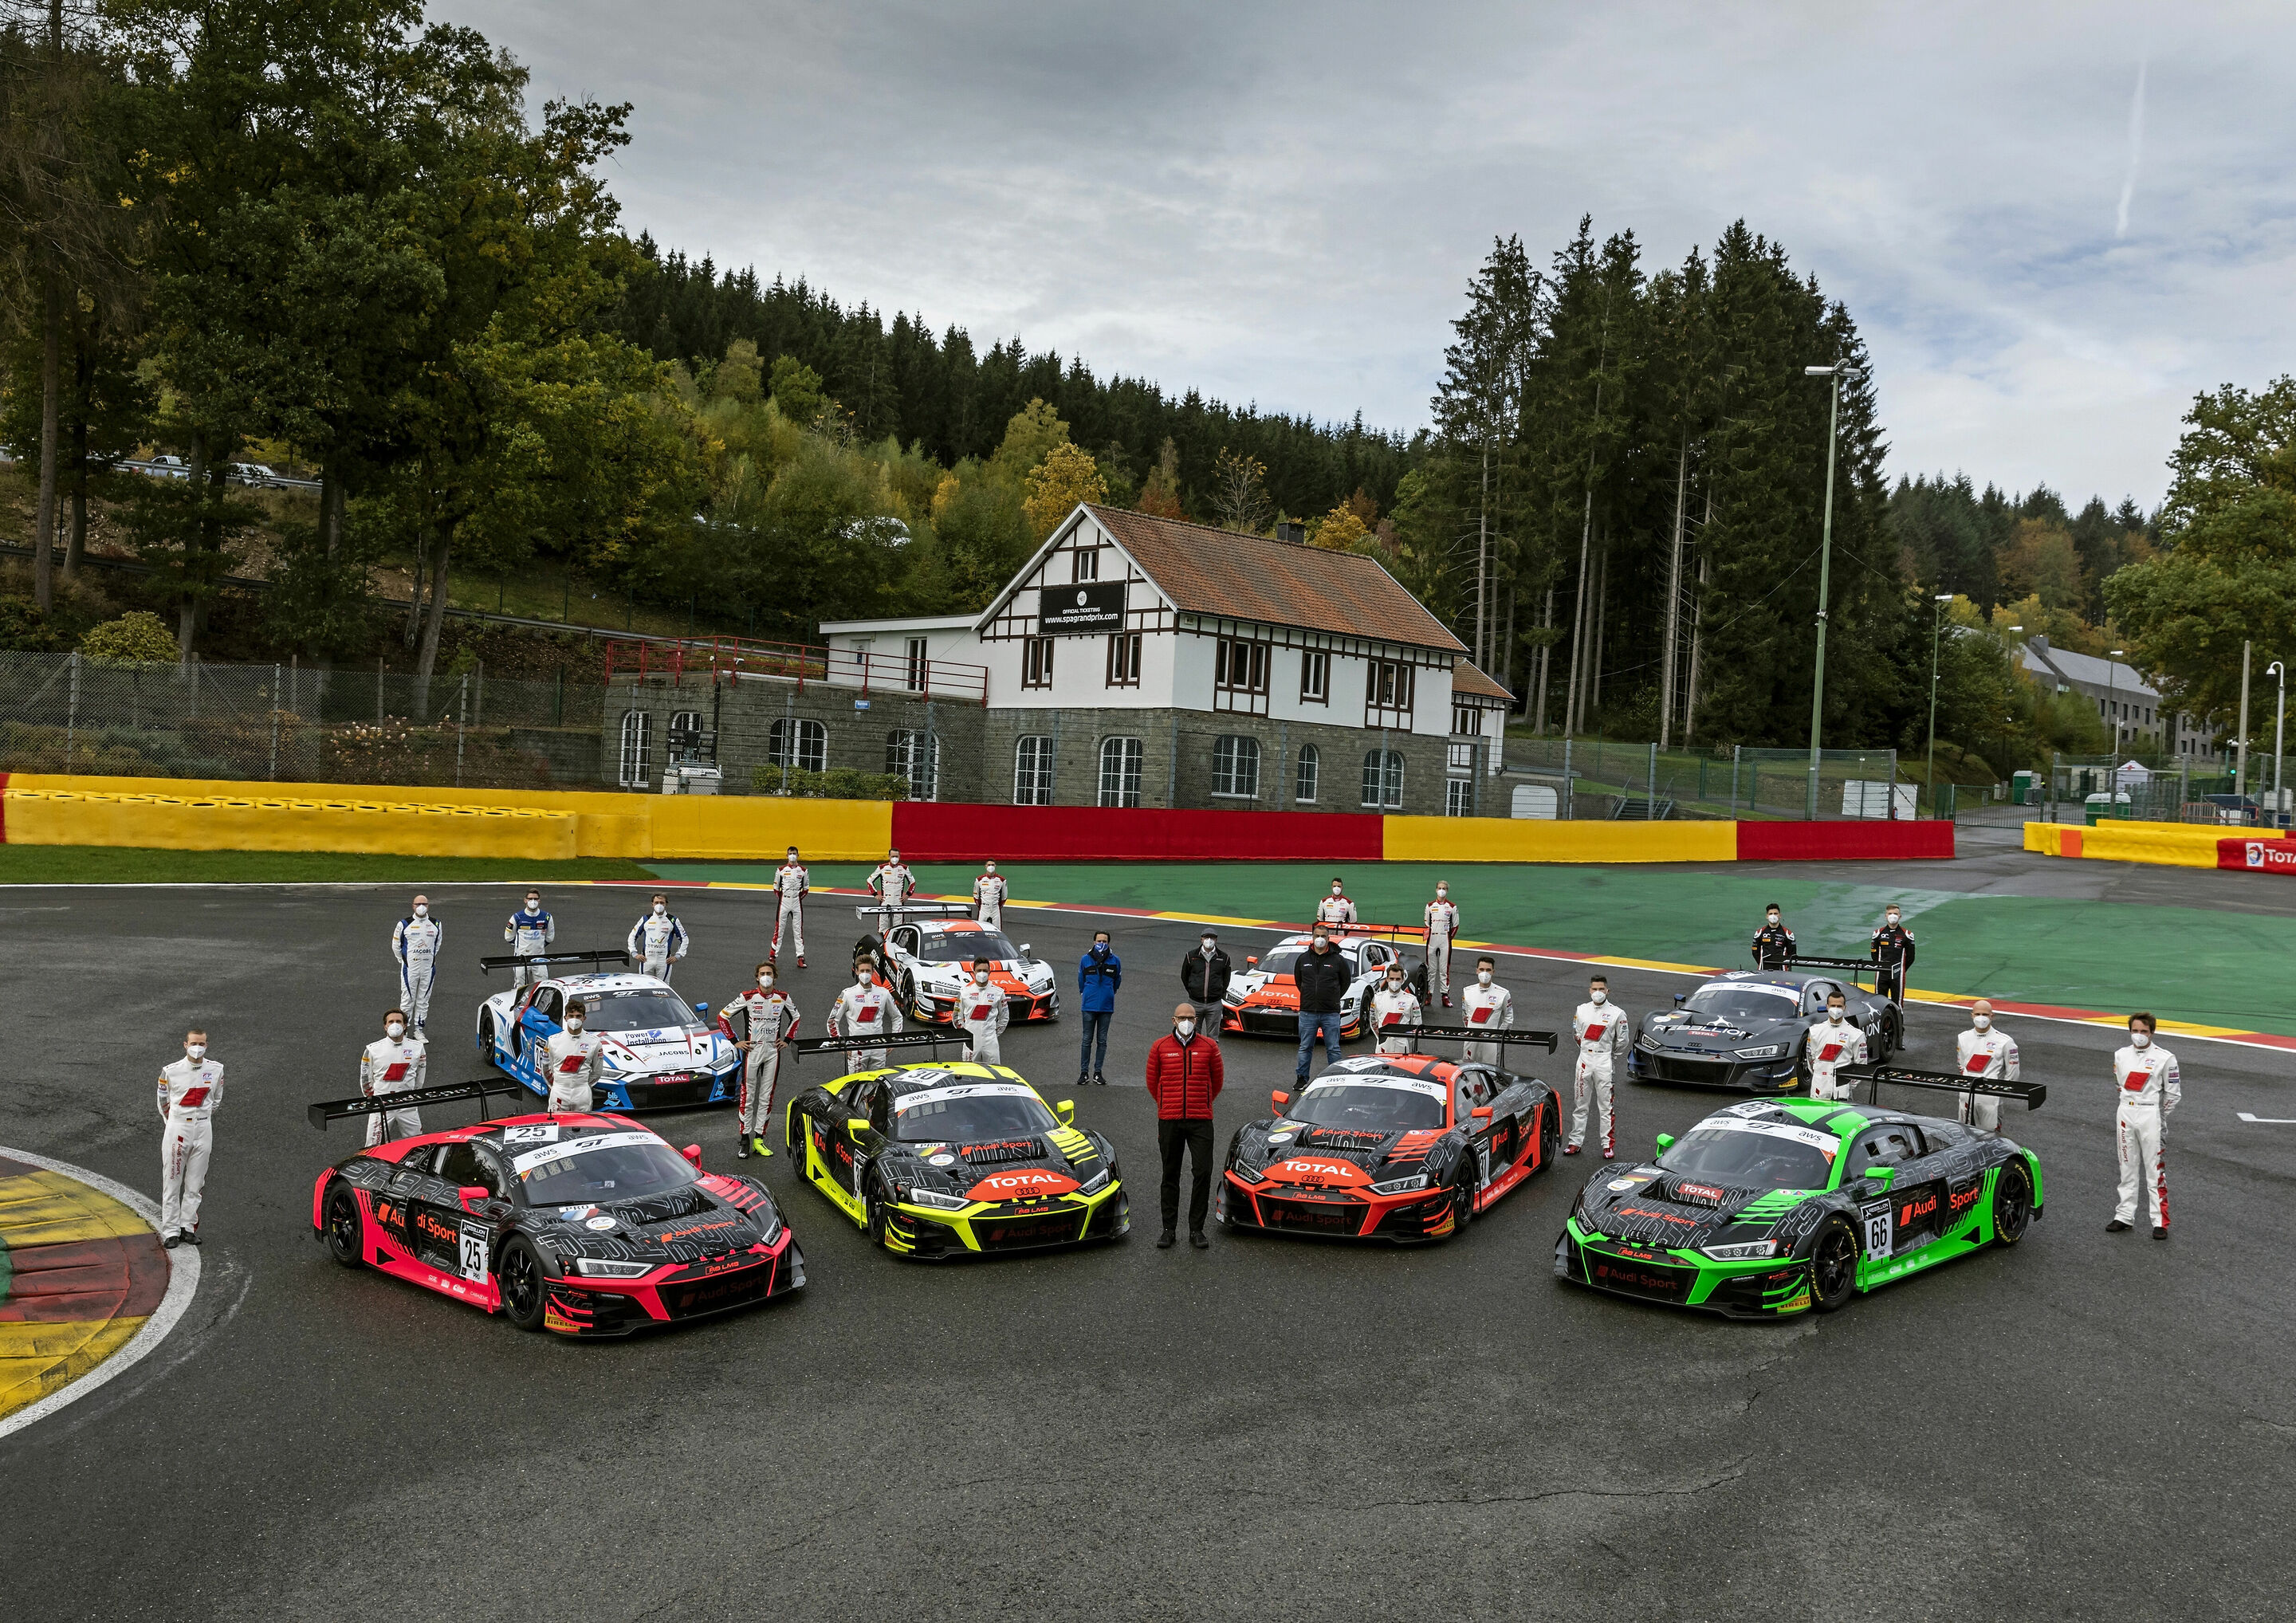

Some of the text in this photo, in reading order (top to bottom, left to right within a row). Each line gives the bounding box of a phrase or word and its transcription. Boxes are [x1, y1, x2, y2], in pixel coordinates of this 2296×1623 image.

[1045, 613, 1118, 623] www.spagrandprix.com
[627, 1036, 666, 1045] Installation
[908, 1070, 937, 1080] 30
[1412, 1082, 1432, 1091] aws
[909, 1093, 930, 1102] aws
[1710, 1118, 1732, 1126] aws
[517, 1127, 547, 1138] 25
[1354, 1130, 1383, 1140] Sport
[1799, 1130, 1822, 1142] aws
[576, 1138, 610, 1149] GT
[975, 1141, 1032, 1151] Audi Sport
[534, 1148, 557, 1159] aws
[1284, 1161, 1353, 1177] TOTAL
[985, 1175, 1062, 1189] TOTAL
[1684, 1185, 1718, 1198] TOTAL
[1913, 1188, 1978, 1217] Audi Sport
[1286, 1212, 1352, 1225] Audi Sport
[1635, 1208, 1697, 1228] Audi Sport
[427, 1217, 457, 1244] Sport
[675, 1220, 736, 1237] Audi Sport
[1008, 1224, 1072, 1238] Audi Sport
[1871, 1217, 1887, 1249] 66
[466, 1239, 482, 1272] 25
[721, 1261, 740, 1271] LMS
[1610, 1268, 1678, 1290] Audi Sport
[698, 1277, 765, 1302] Audi Sport
[1780, 1299, 1810, 1309] PIRELLI
